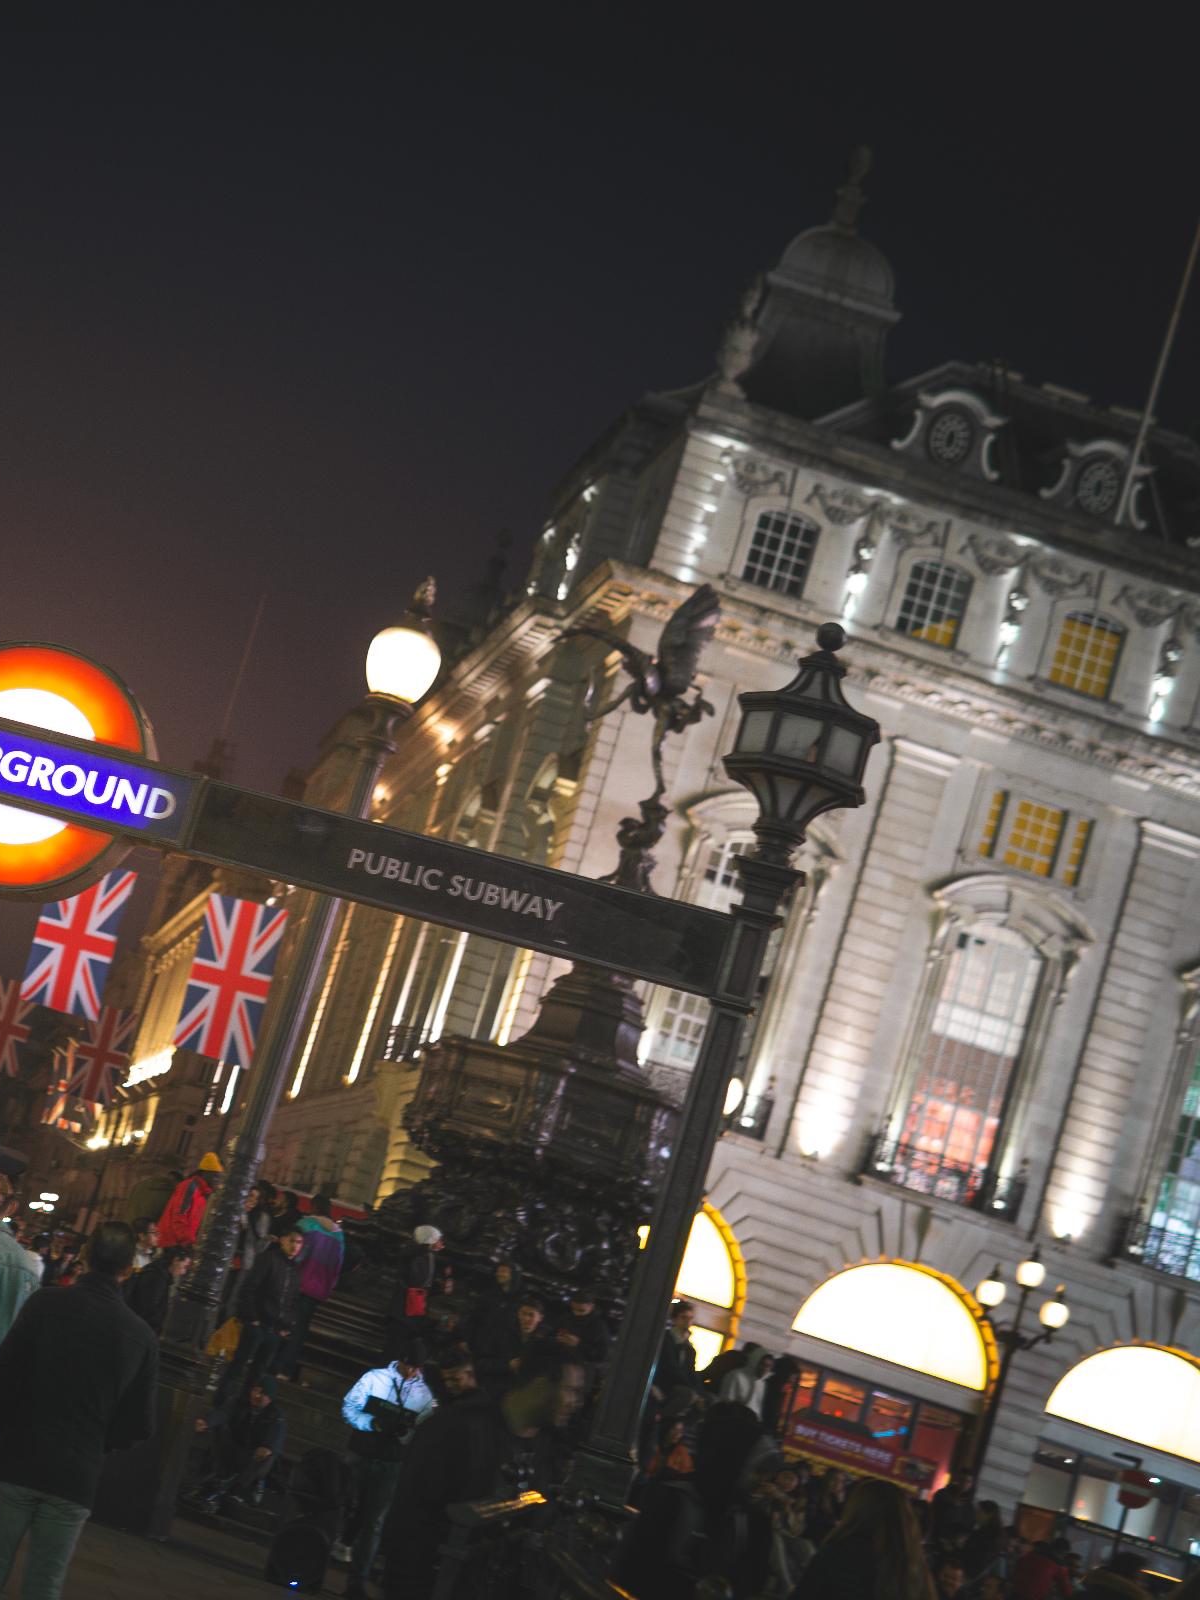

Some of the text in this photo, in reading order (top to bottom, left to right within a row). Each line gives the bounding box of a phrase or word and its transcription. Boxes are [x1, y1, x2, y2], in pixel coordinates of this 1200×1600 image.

[347, 849, 564, 921] PUBLIC SUBWAY
[794, 1424, 818, 1439] BUY
[818, 1430, 862, 1453] TICKETS
[863, 1446, 892, 1463] HERE
